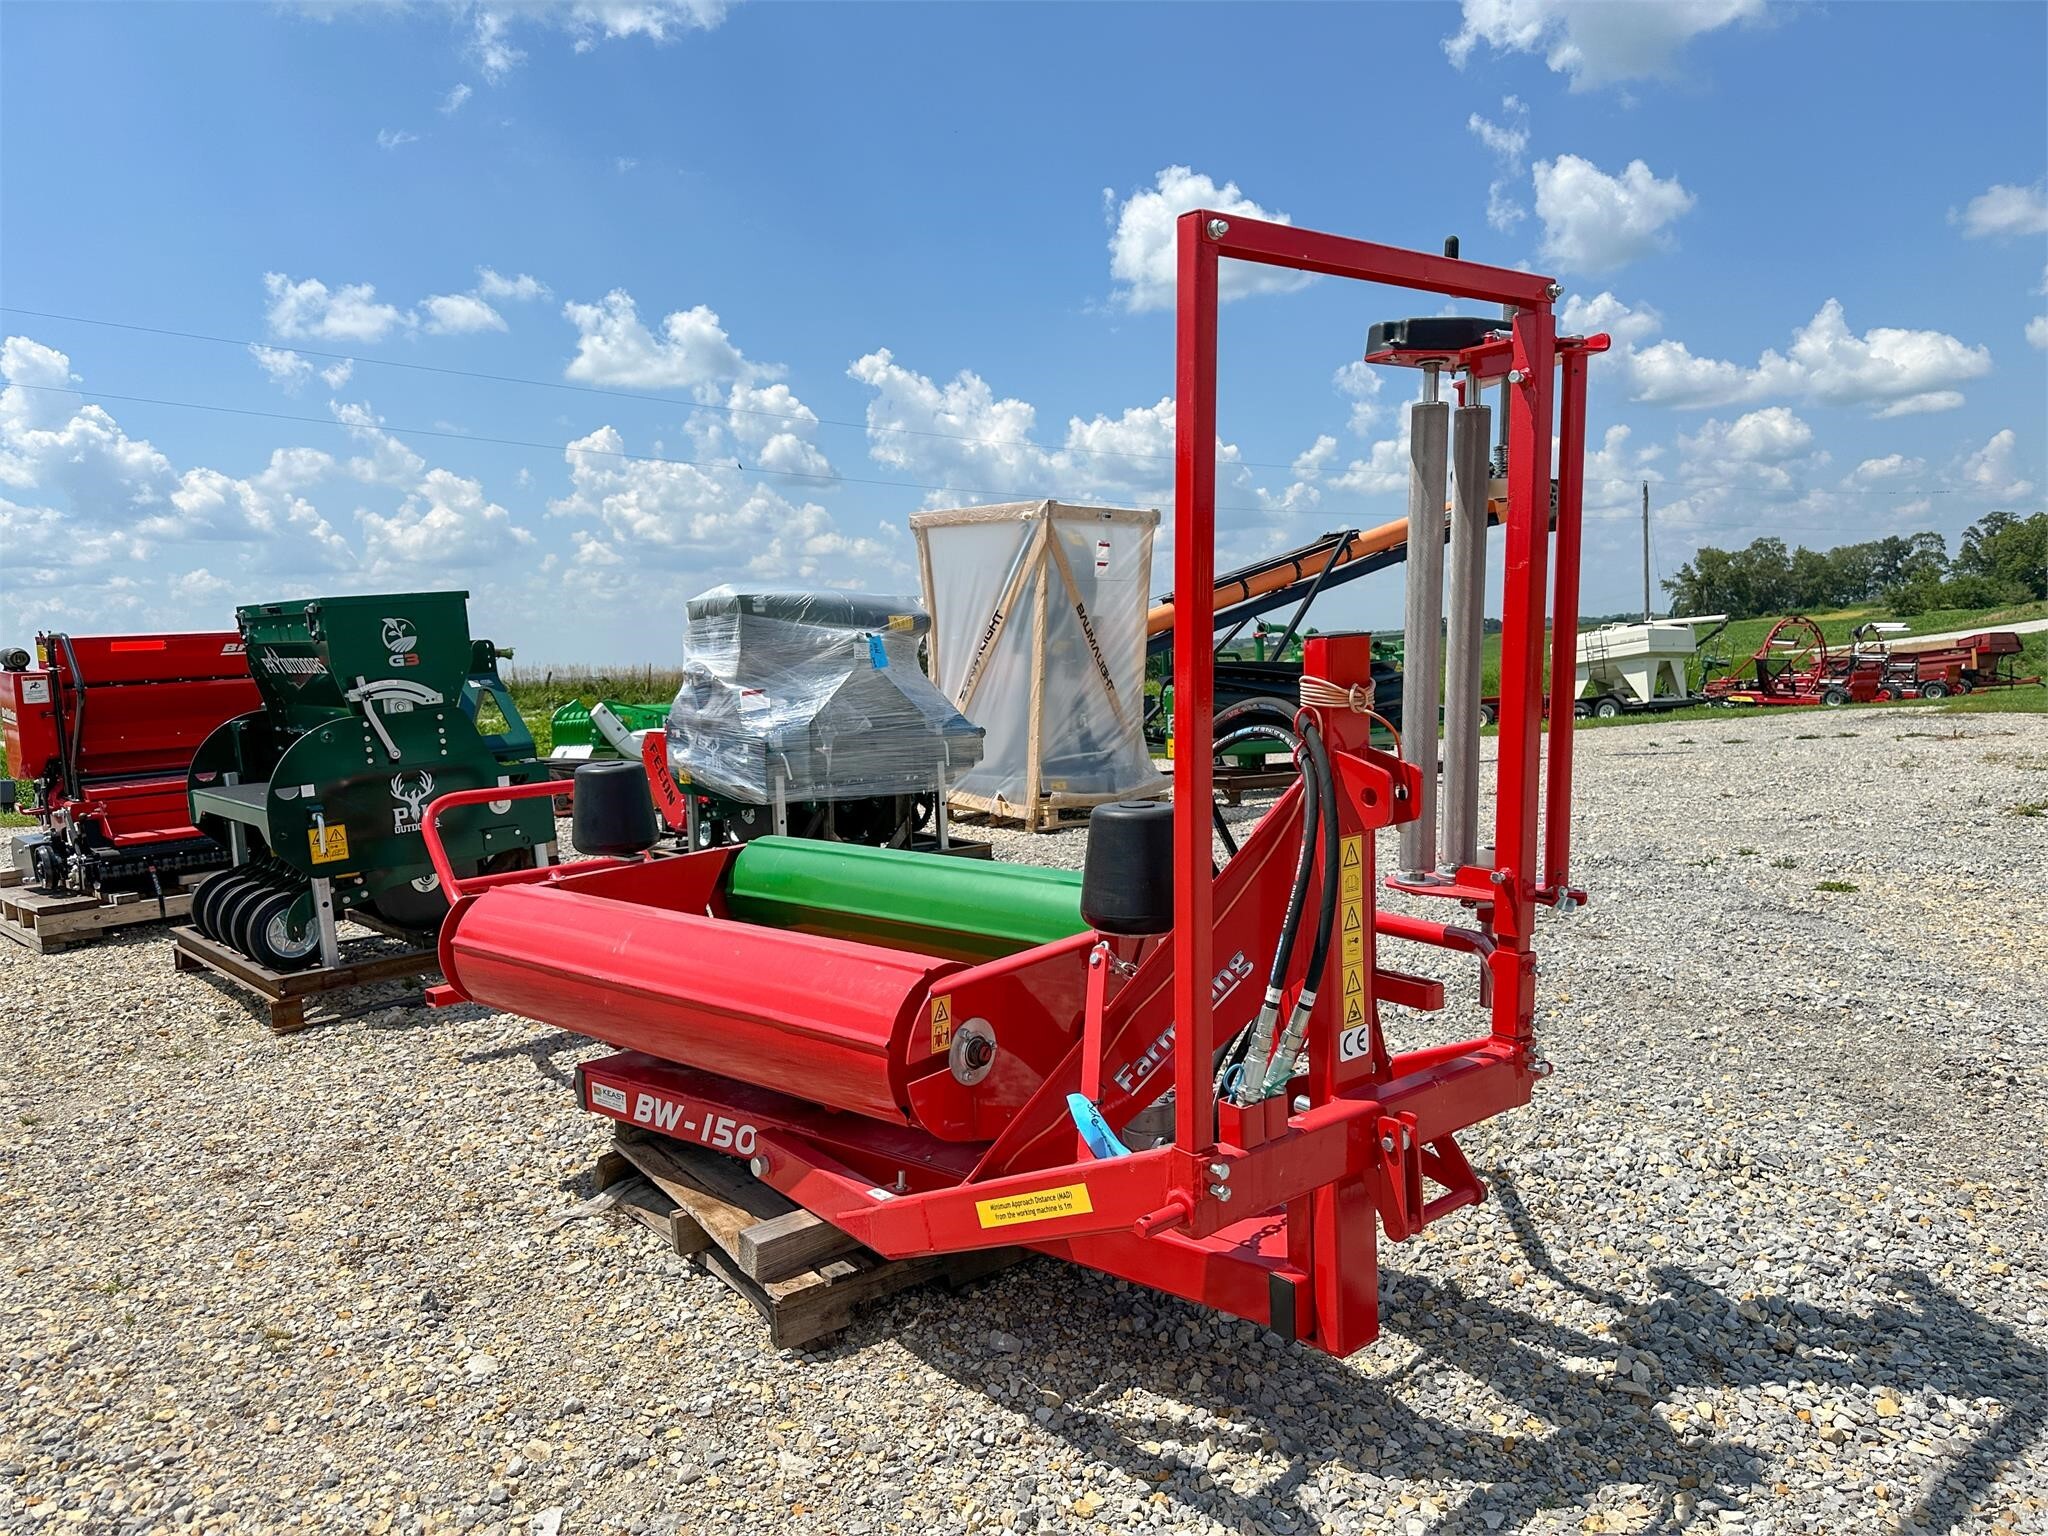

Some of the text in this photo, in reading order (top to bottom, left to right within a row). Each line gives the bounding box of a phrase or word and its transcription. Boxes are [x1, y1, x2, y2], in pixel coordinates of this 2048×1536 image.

[389, 653, 420, 667] G3
[1076, 602, 1115, 690] BAUMALIGHT
[649, 743, 675, 805] FECON
[1113, 950, 1254, 1092] Farmng
[602, 1088, 624, 1101] KEAST
[633, 1093, 757, 1155] BW-150
[990, 1191, 1072, 1211] Minimum Approach Distance (MAD)
[995, 1212, 1007, 1220] from
[1008, 1210, 1016, 1218] the
[1017, 1208, 1036, 1217] working
[1036, 1204, 1058, 1213] machine
[1064, 1202, 1073, 1210] 1m
